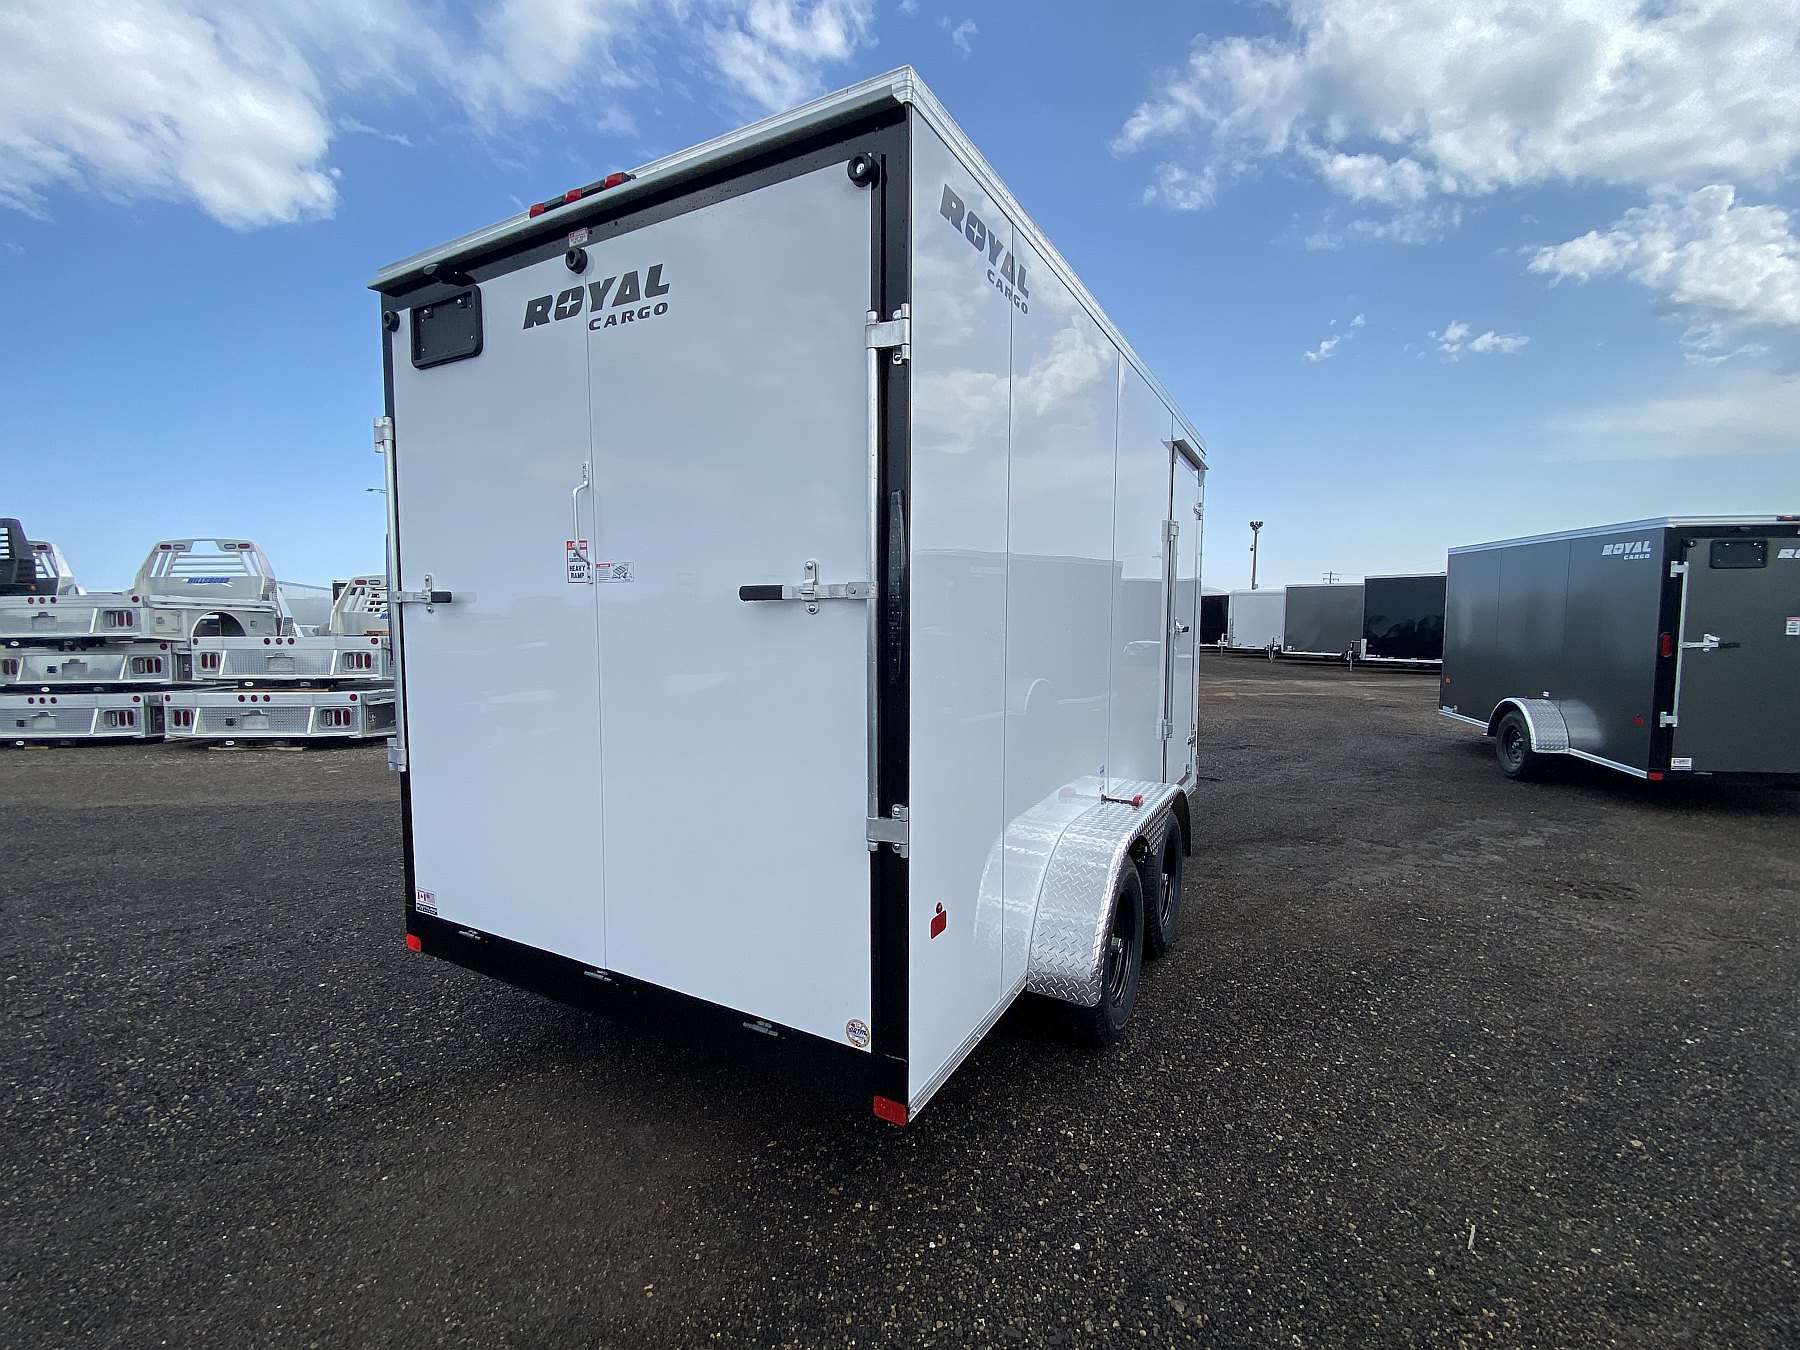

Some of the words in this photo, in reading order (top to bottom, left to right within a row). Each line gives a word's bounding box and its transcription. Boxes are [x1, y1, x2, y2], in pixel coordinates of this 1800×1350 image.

[940, 184, 1029, 299] ROYAL
[523, 264, 670, 329] ROYAL
[987, 269, 1028, 315] CARGO
[589, 302, 669, 331] CARGO
[1601, 540, 1652, 556] ROYAL
